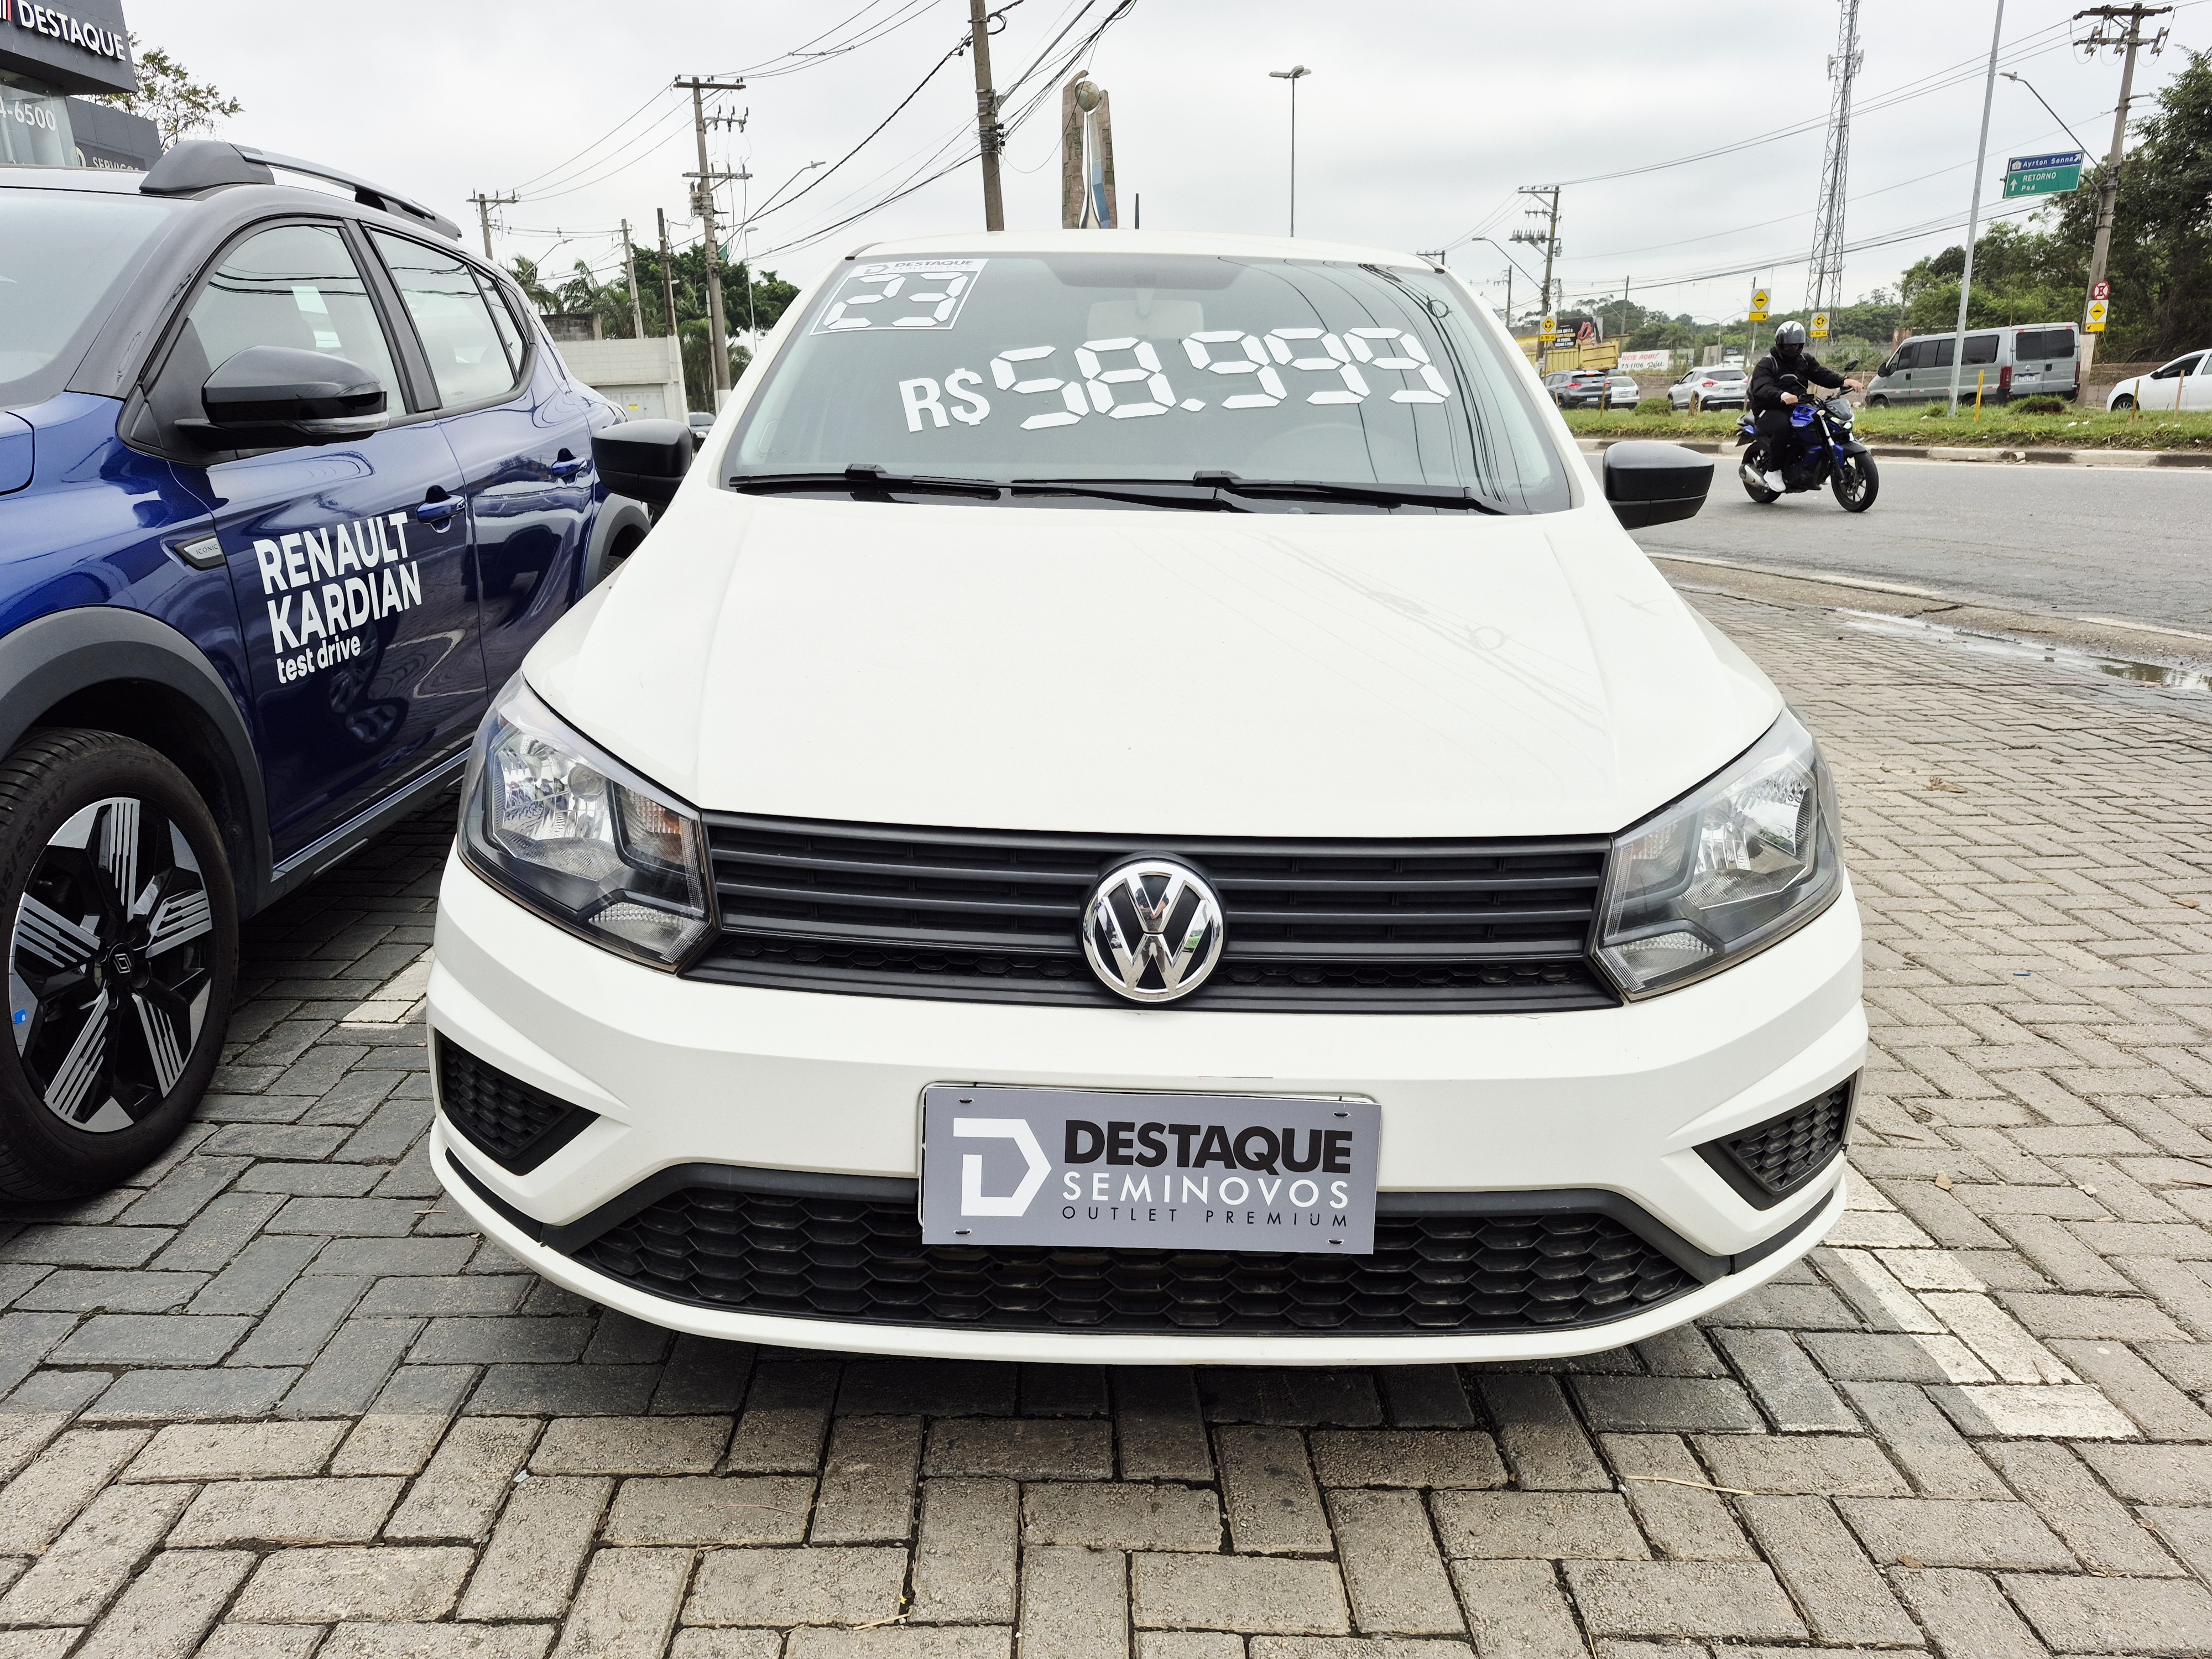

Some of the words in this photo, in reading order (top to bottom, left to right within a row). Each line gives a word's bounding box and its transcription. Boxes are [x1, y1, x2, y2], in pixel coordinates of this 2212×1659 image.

[17, 0, 126, 61] DESTAQUE
[2022, 159, 2047, 168] Ayrton
[2051, 156, 2073, 165] Senna
[2023, 172, 2057, 182] RETORNO
[823, 272, 969, 330] 23
[898, 368, 990, 432] R$
[989, 327, 1451, 430] 58.999
[196, 544, 218, 555] ICONIC
[252, 512, 408, 594] RENAULT
[266, 561, 422, 655] KARDIAN
[276, 647, 315, 684] test
[317, 635, 361, 669] drive
[1082, 861, 1224, 1003] VW
[1064, 1119, 1353, 1176] DESTAQUE
[1062, 1206, 1177, 1222] OUTLET
[1206, 1211, 1348, 1227] PREMIUM
[1063, 1171, 1349, 1209] SEMINOVOS
